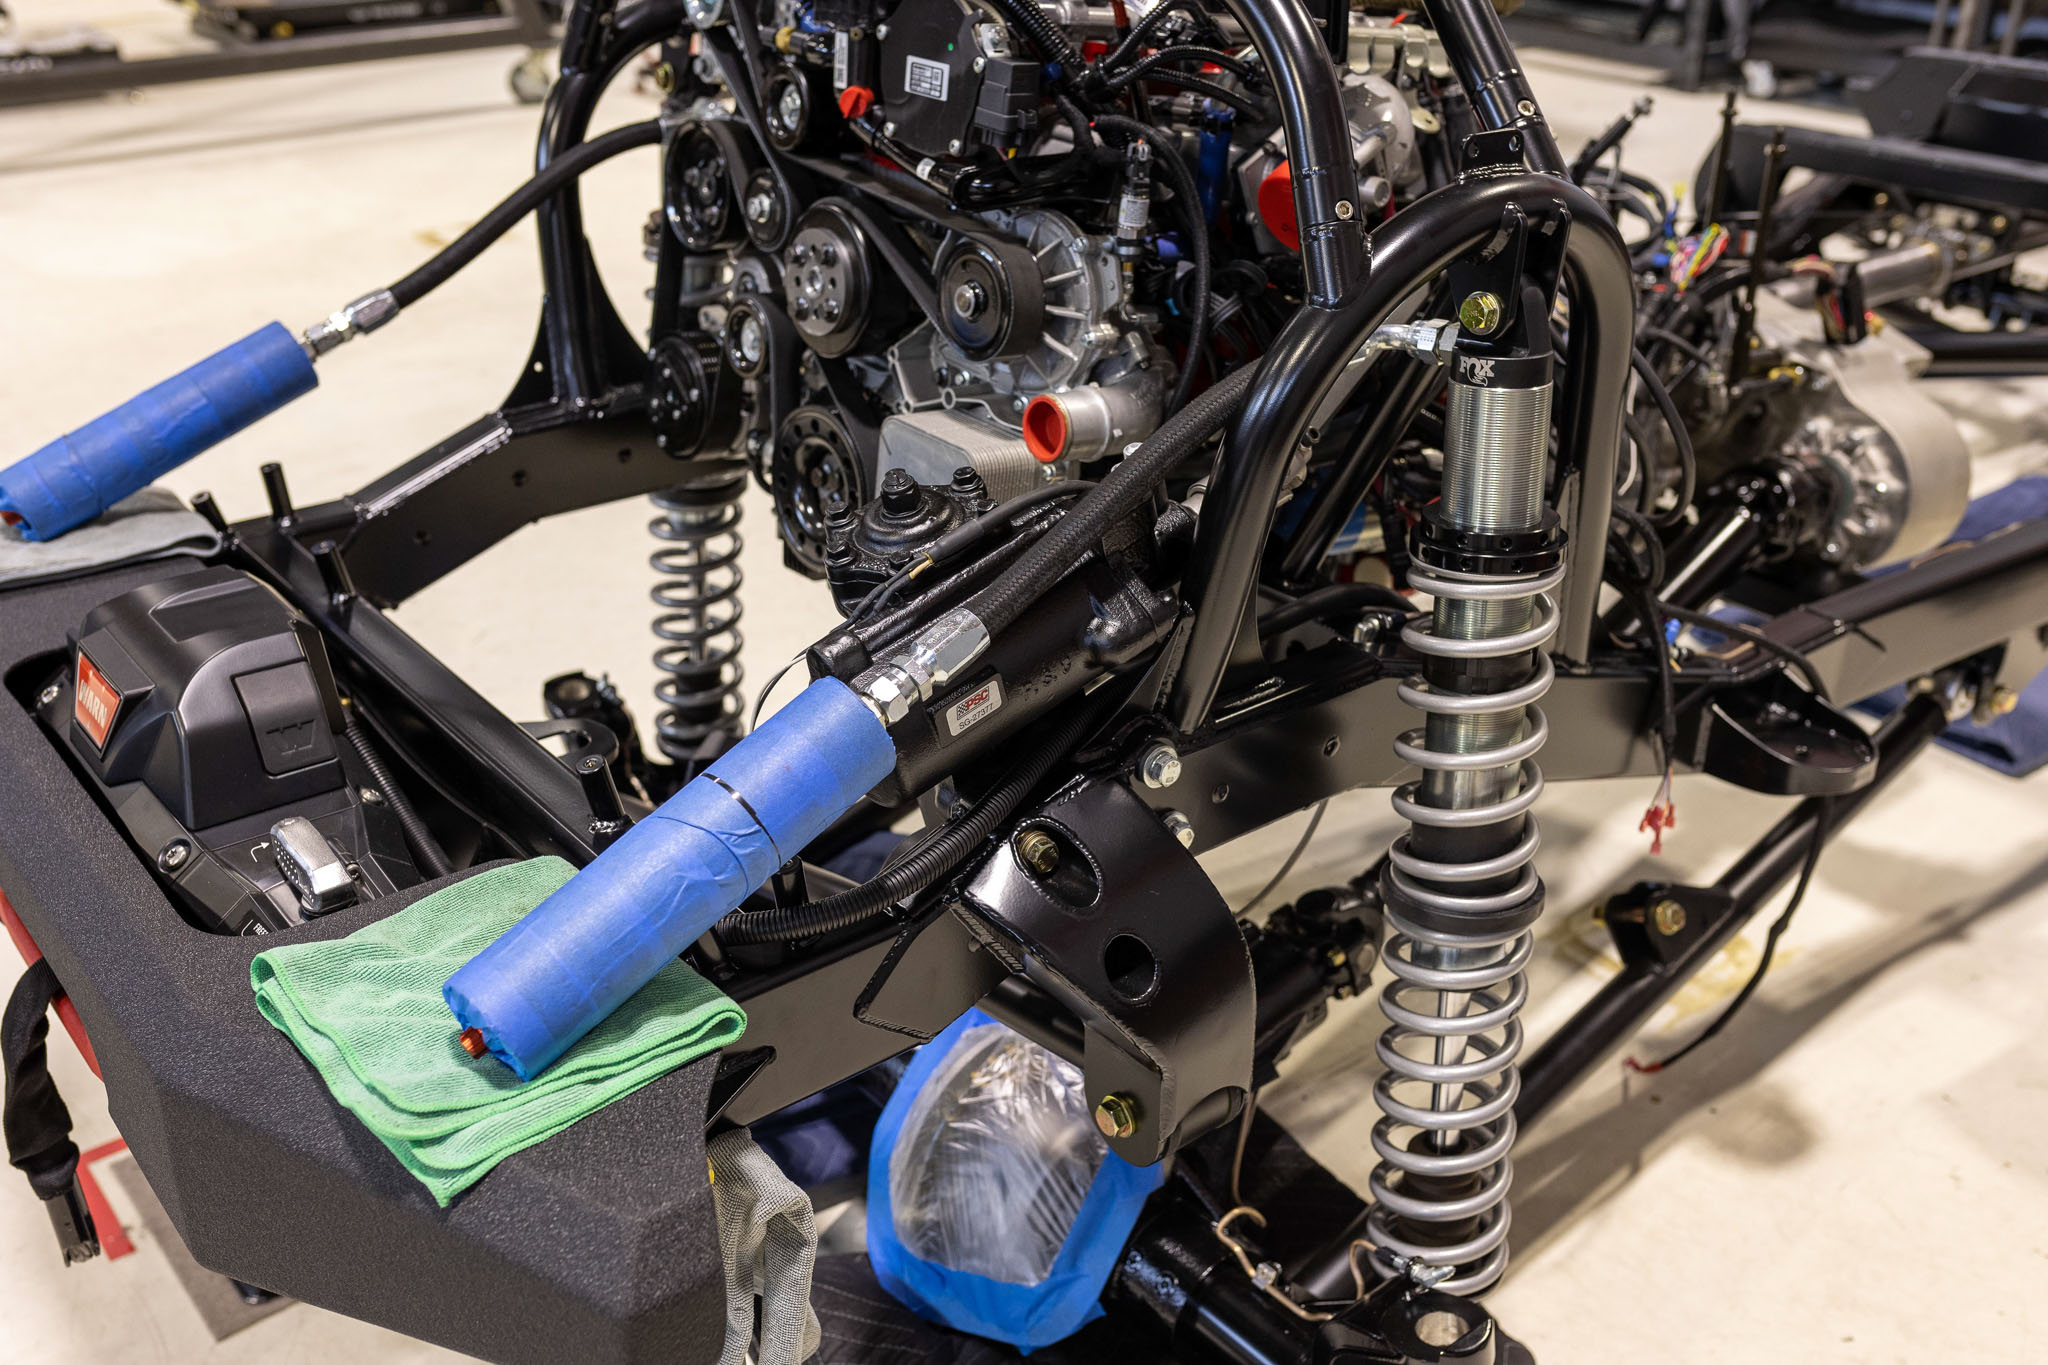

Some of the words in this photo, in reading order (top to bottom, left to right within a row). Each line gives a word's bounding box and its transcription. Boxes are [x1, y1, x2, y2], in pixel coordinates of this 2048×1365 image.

[1459, 356, 1495, 386] FOX
[79, 679, 108, 728] WARN
[965, 688, 989, 711] PSC
[253, 922, 269, 936] FREE
